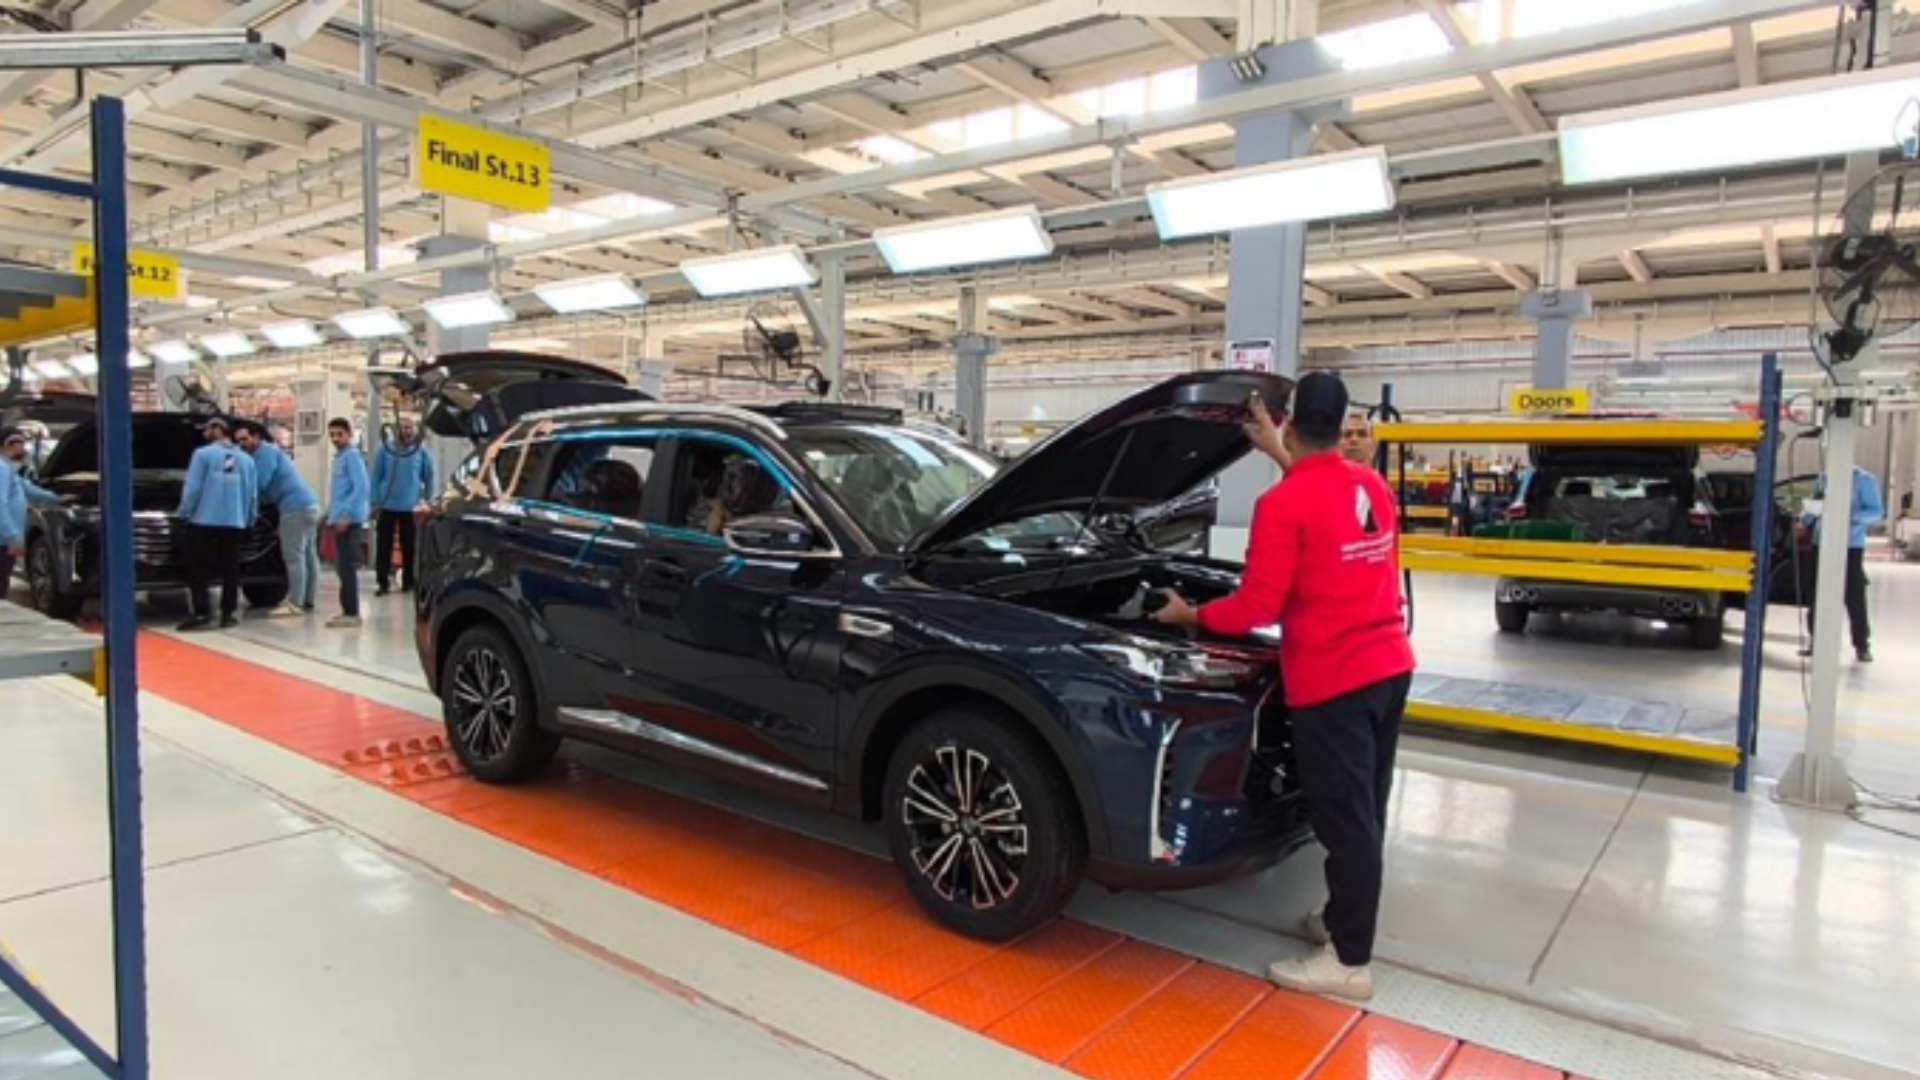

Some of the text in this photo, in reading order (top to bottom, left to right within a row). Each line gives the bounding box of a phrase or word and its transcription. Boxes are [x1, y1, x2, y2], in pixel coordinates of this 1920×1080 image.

[427, 139, 541, 188] Final St.13
[1518, 394, 1575, 409] Doors
